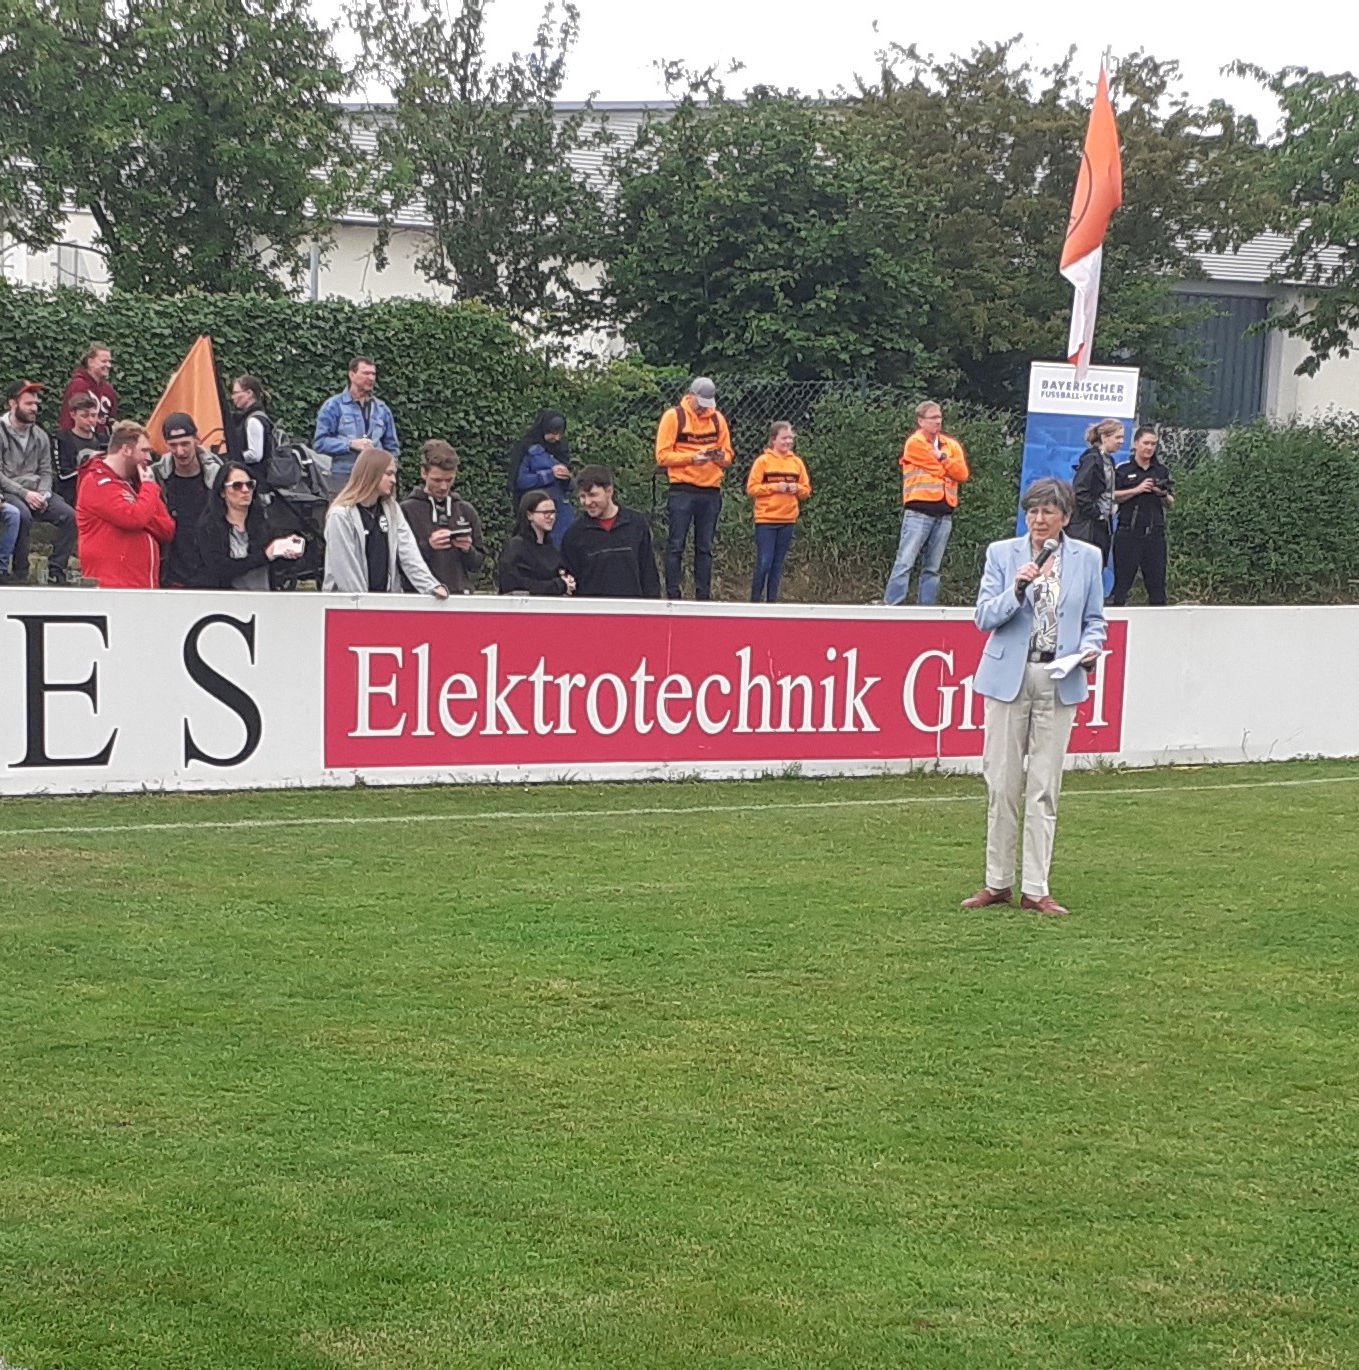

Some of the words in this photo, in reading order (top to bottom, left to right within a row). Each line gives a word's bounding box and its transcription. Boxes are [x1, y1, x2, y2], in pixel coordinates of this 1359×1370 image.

[1042, 380, 1124, 394] BAYERISCHER
[1041, 391, 1123, 402] FUSSBALL-VERBAND
[347, 642, 882, 737] Elektrotechnik
[903, 649, 1113, 733] GH
